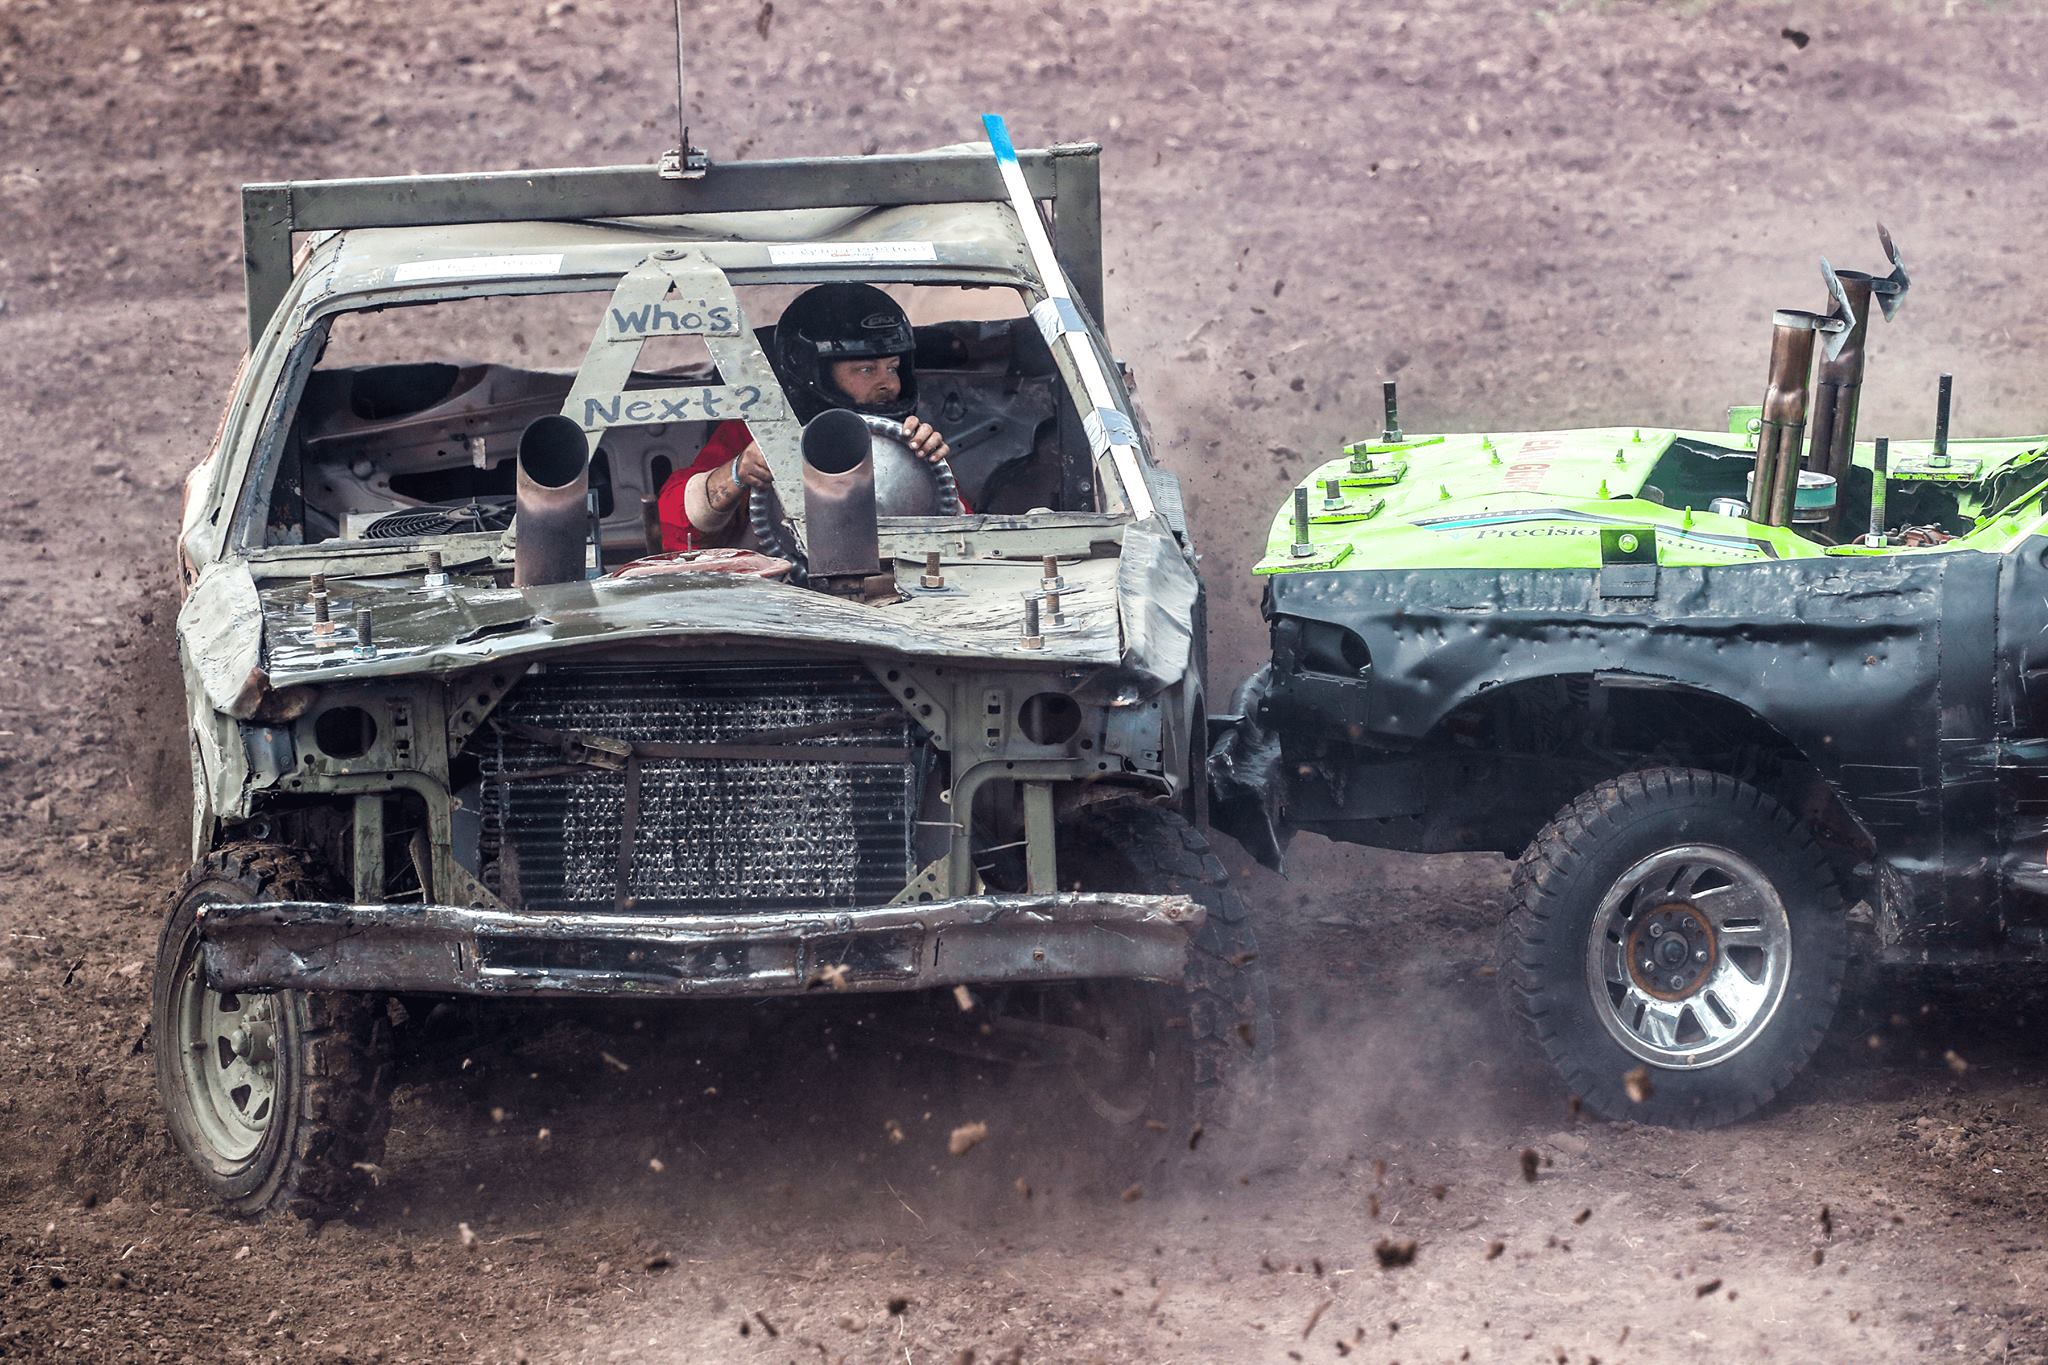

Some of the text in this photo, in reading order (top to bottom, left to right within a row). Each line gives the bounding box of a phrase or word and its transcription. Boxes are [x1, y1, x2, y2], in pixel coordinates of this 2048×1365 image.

[611, 299, 733, 334] Who's
[584, 386, 762, 427] Next?
[1476, 525, 1599, 540] Precisio
